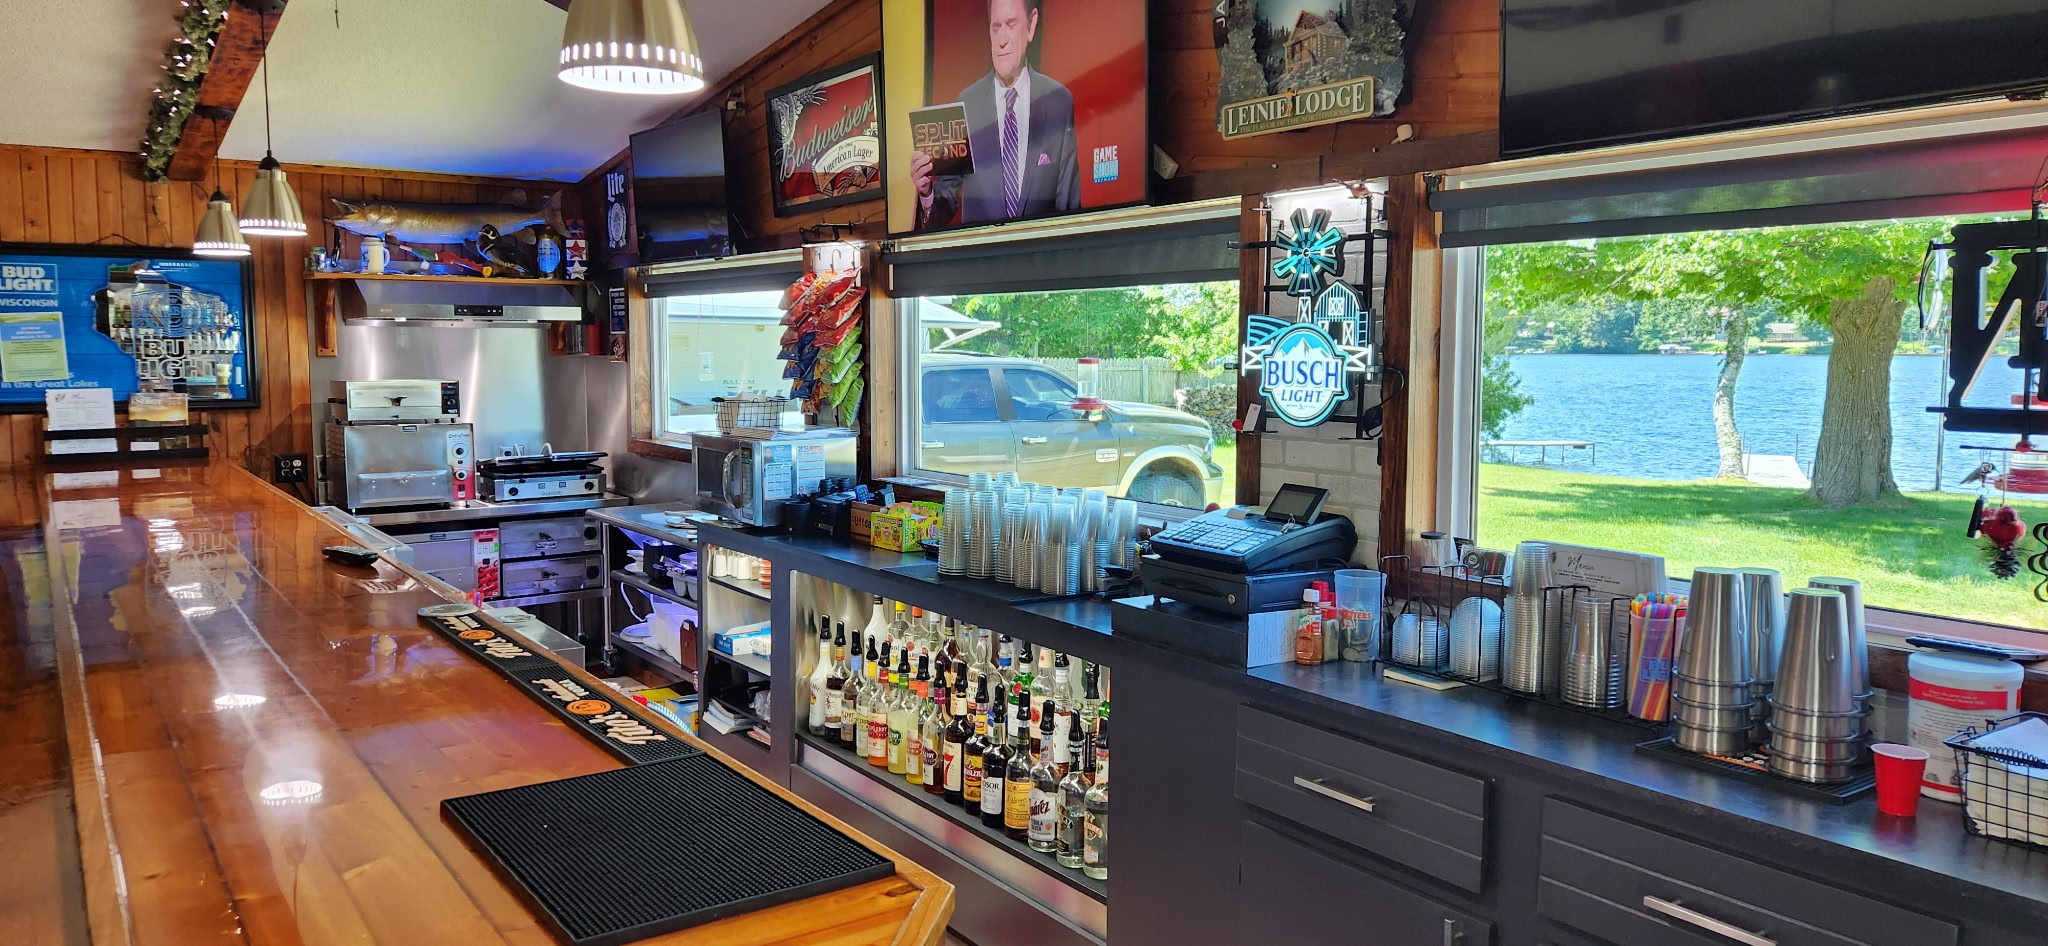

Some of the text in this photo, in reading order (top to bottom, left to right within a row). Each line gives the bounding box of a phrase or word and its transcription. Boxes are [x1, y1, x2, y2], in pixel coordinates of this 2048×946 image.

[1228, 83, 1366, 135] LEINIE LODGE
[775, 97, 875, 182] Budweiser
[915, 119, 966, 145] SPLIT
[823, 145, 874, 178] American Lager
[1093, 145, 1118, 163] GAME
[1094, 160, 1118, 179] SHOW
[606, 172, 625, 202] Lite
[2, 265, 46, 278] BUD
[0, 278, 54, 291] LIGHT
[136, 358, 216, 380] LIGHT
[1267, 360, 1340, 389] BUSCH
[14, 380, 33, 388] the
[35, 380, 66, 388] Great
[68, 379, 99, 387] Lakes
[1281, 389, 1323, 403] LIGHT
